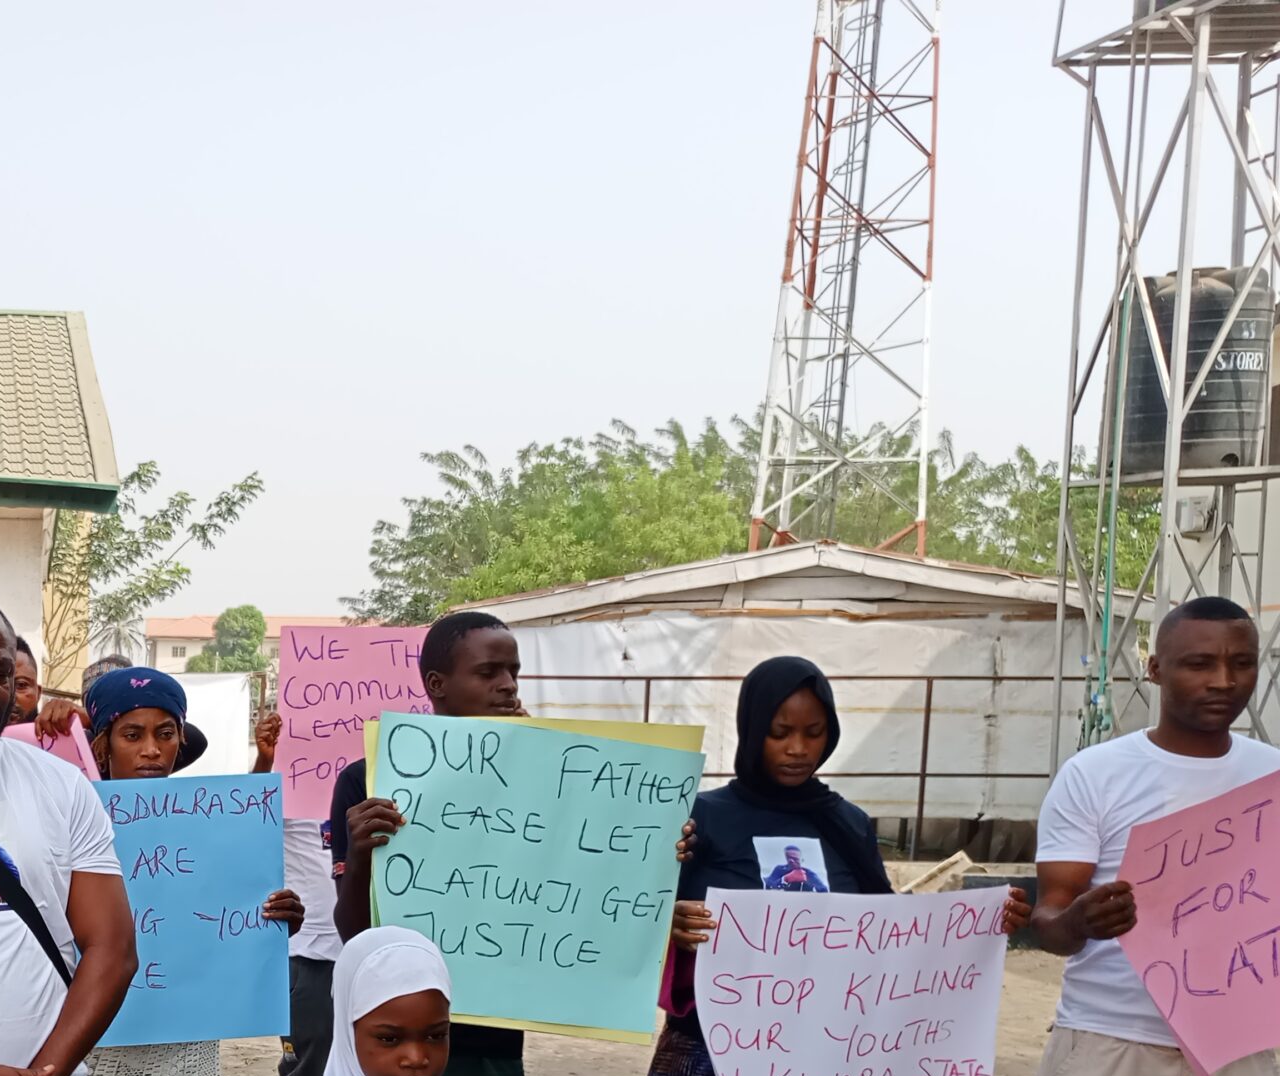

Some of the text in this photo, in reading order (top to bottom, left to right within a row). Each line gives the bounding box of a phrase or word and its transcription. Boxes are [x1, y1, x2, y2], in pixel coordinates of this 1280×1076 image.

[291, 631, 421, 668] WE TH
[284, 676, 430, 709] COMMUN
[387, 724, 696, 811] OUR FATHER
[108, 787, 278, 826] BDULRASAK
[129, 845, 194, 881] ARE
[578, 819, 661, 861] LET
[1136, 799, 1272, 885] JUST
[384, 853, 672, 922] OLATUNJI GET
[1172, 869, 1271, 937] FOR
[404, 912, 601, 967] JUSTICE
[713, 902, 1006, 955] NIGERIAN POLIC
[710, 964, 982, 1014] STOP KILLING
[1143, 926, 1280, 1020] OLAT
[708, 1019, 955, 1063] OUR YOUTHS
